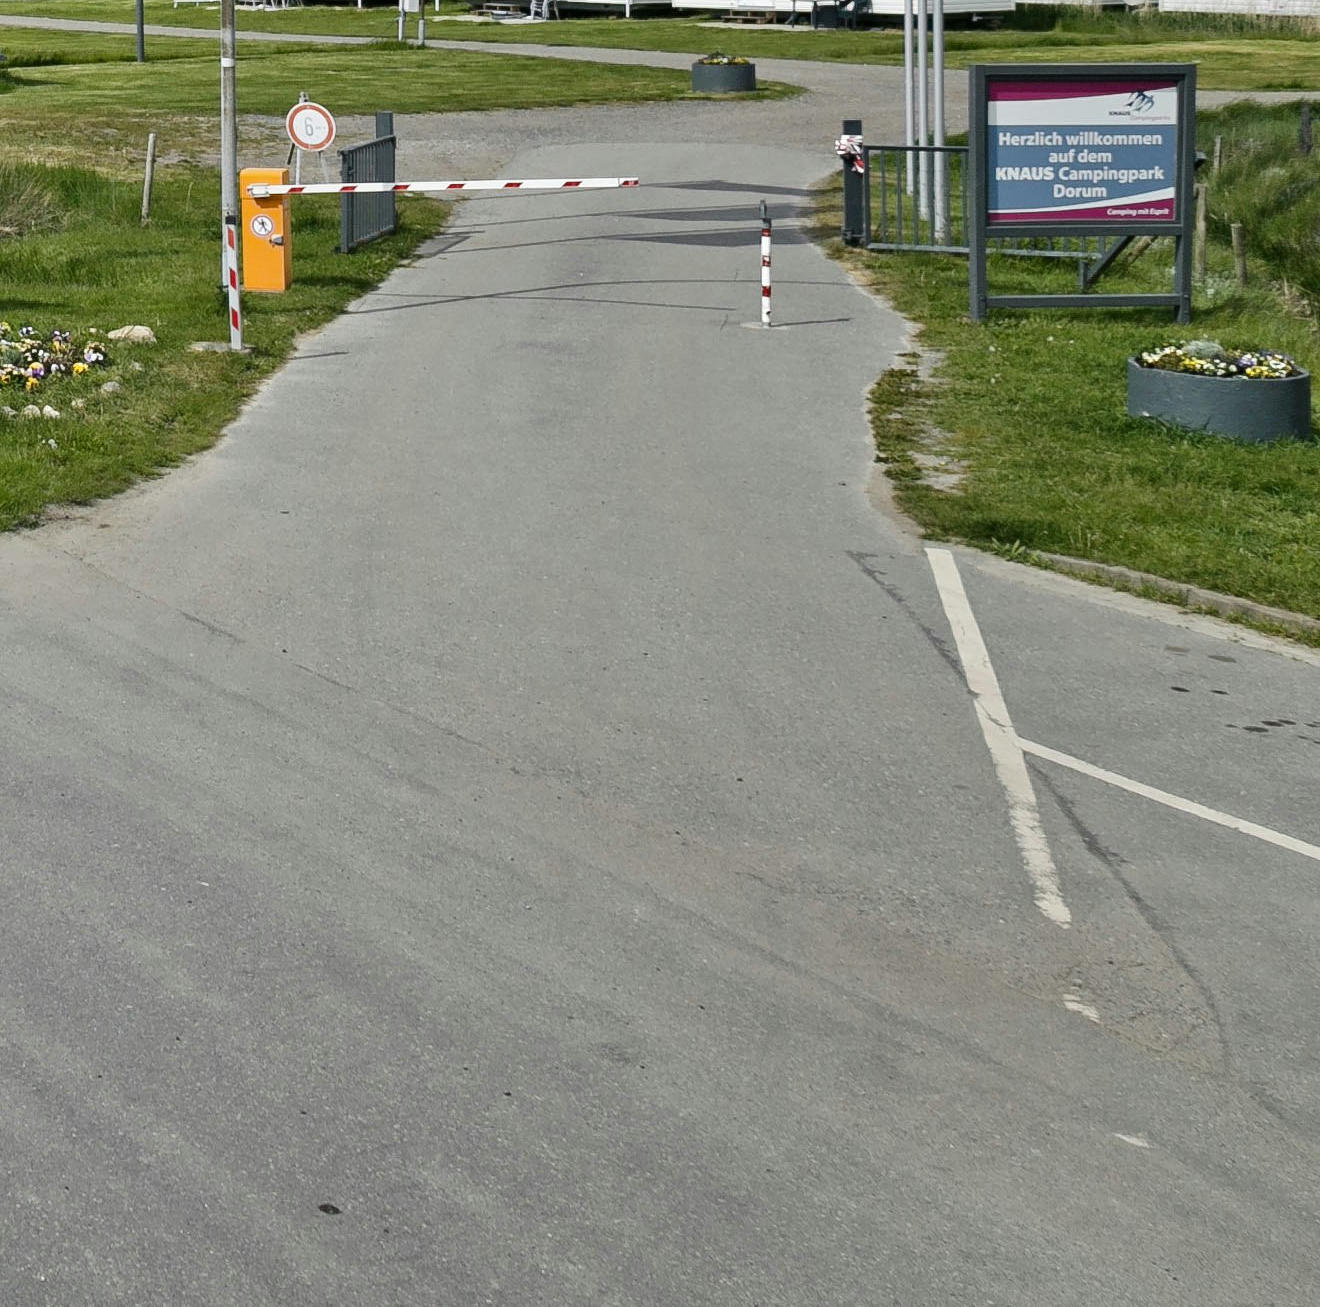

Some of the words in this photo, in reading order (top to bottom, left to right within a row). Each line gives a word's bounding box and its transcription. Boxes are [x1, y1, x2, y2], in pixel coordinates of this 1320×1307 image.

[304, 117, 314, 136] 6
[998, 132, 1062, 146] Herzlich
[1065, 132, 1162, 146] willkommen
[1048, 149, 1076, 163] auf
[1078, 149, 1112, 163] dem
[995, 167, 1054, 181] KNAUS
[1058, 166, 1164, 184] Campingpark
[1053, 184, 1107, 198] Dorum
[1106, 208, 1136, 217] Camping
